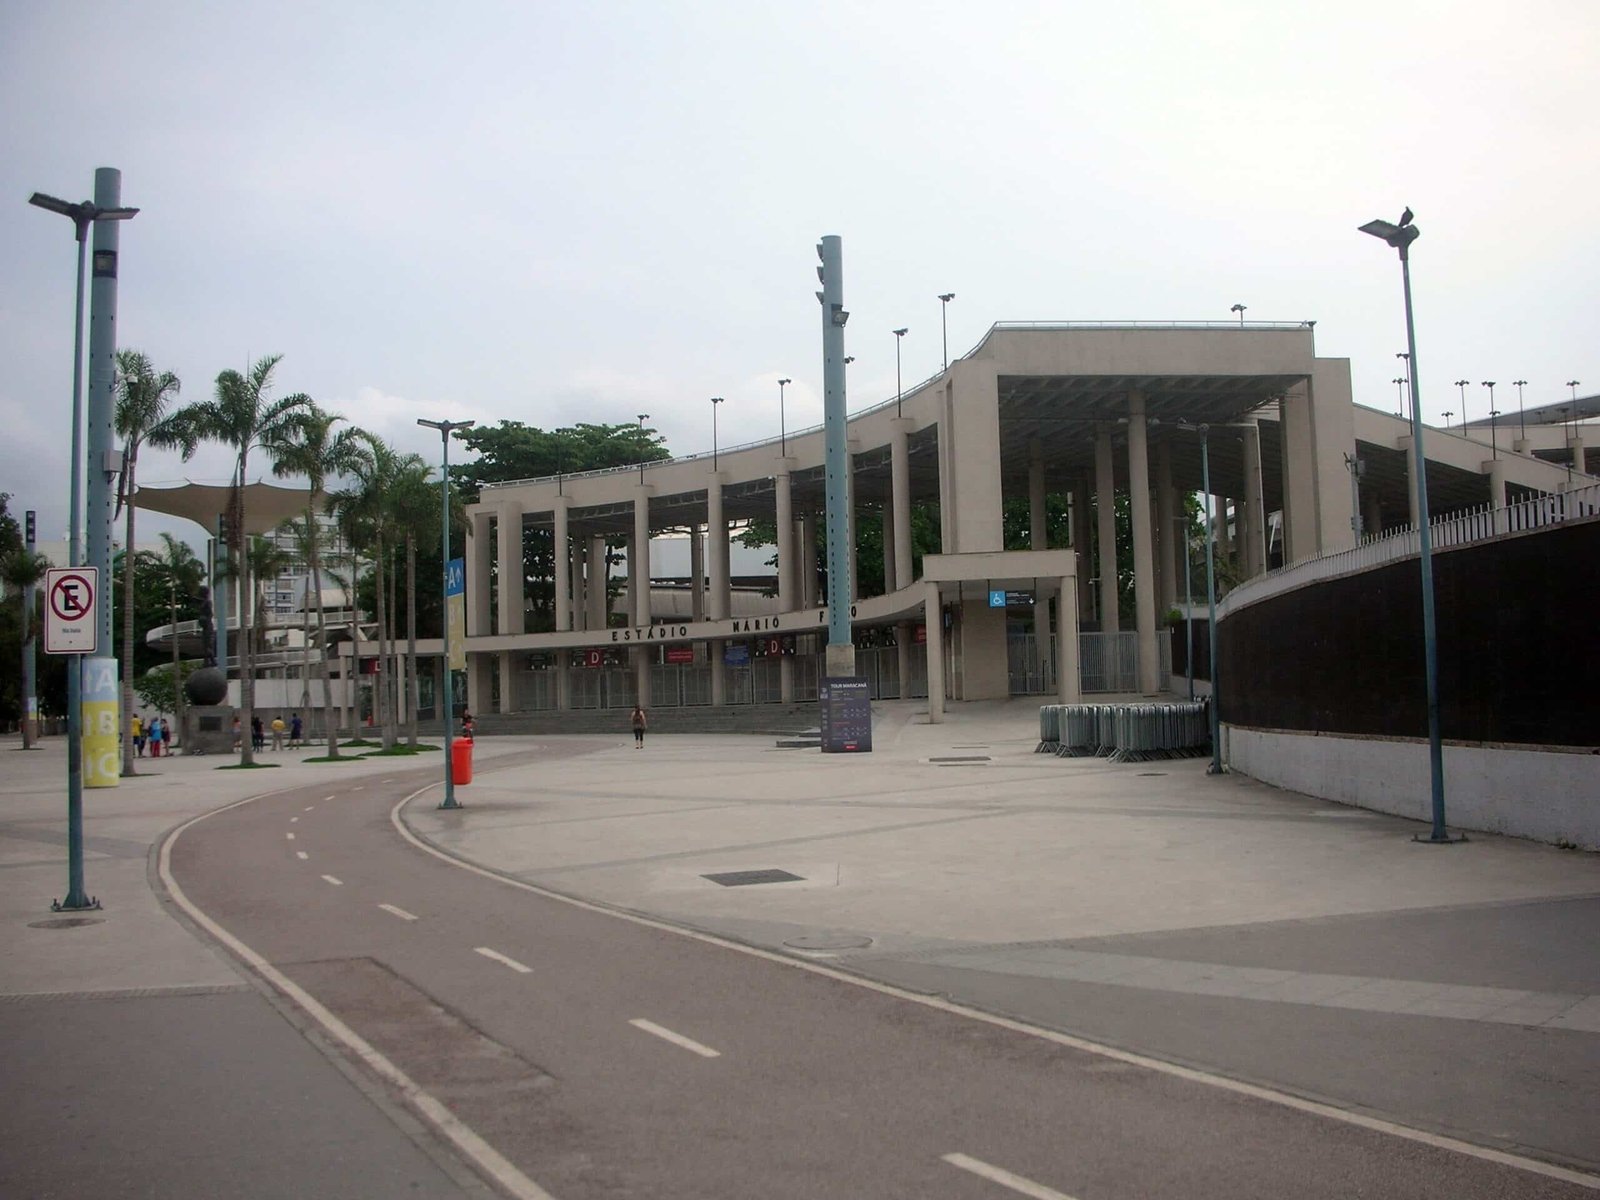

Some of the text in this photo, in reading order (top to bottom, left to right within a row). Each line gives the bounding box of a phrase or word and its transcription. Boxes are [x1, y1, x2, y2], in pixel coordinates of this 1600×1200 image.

[448, 567, 456, 589] A
[64, 585, 79, 611] E
[612, 618, 779, 641] ESTÁDIO MÁRIO
[591, 652, 600, 664] D
[771, 641, 778, 653] D
[96, 669, 116, 692] A
[100, 710, 116, 735] B
[99, 752, 118, 777] C
